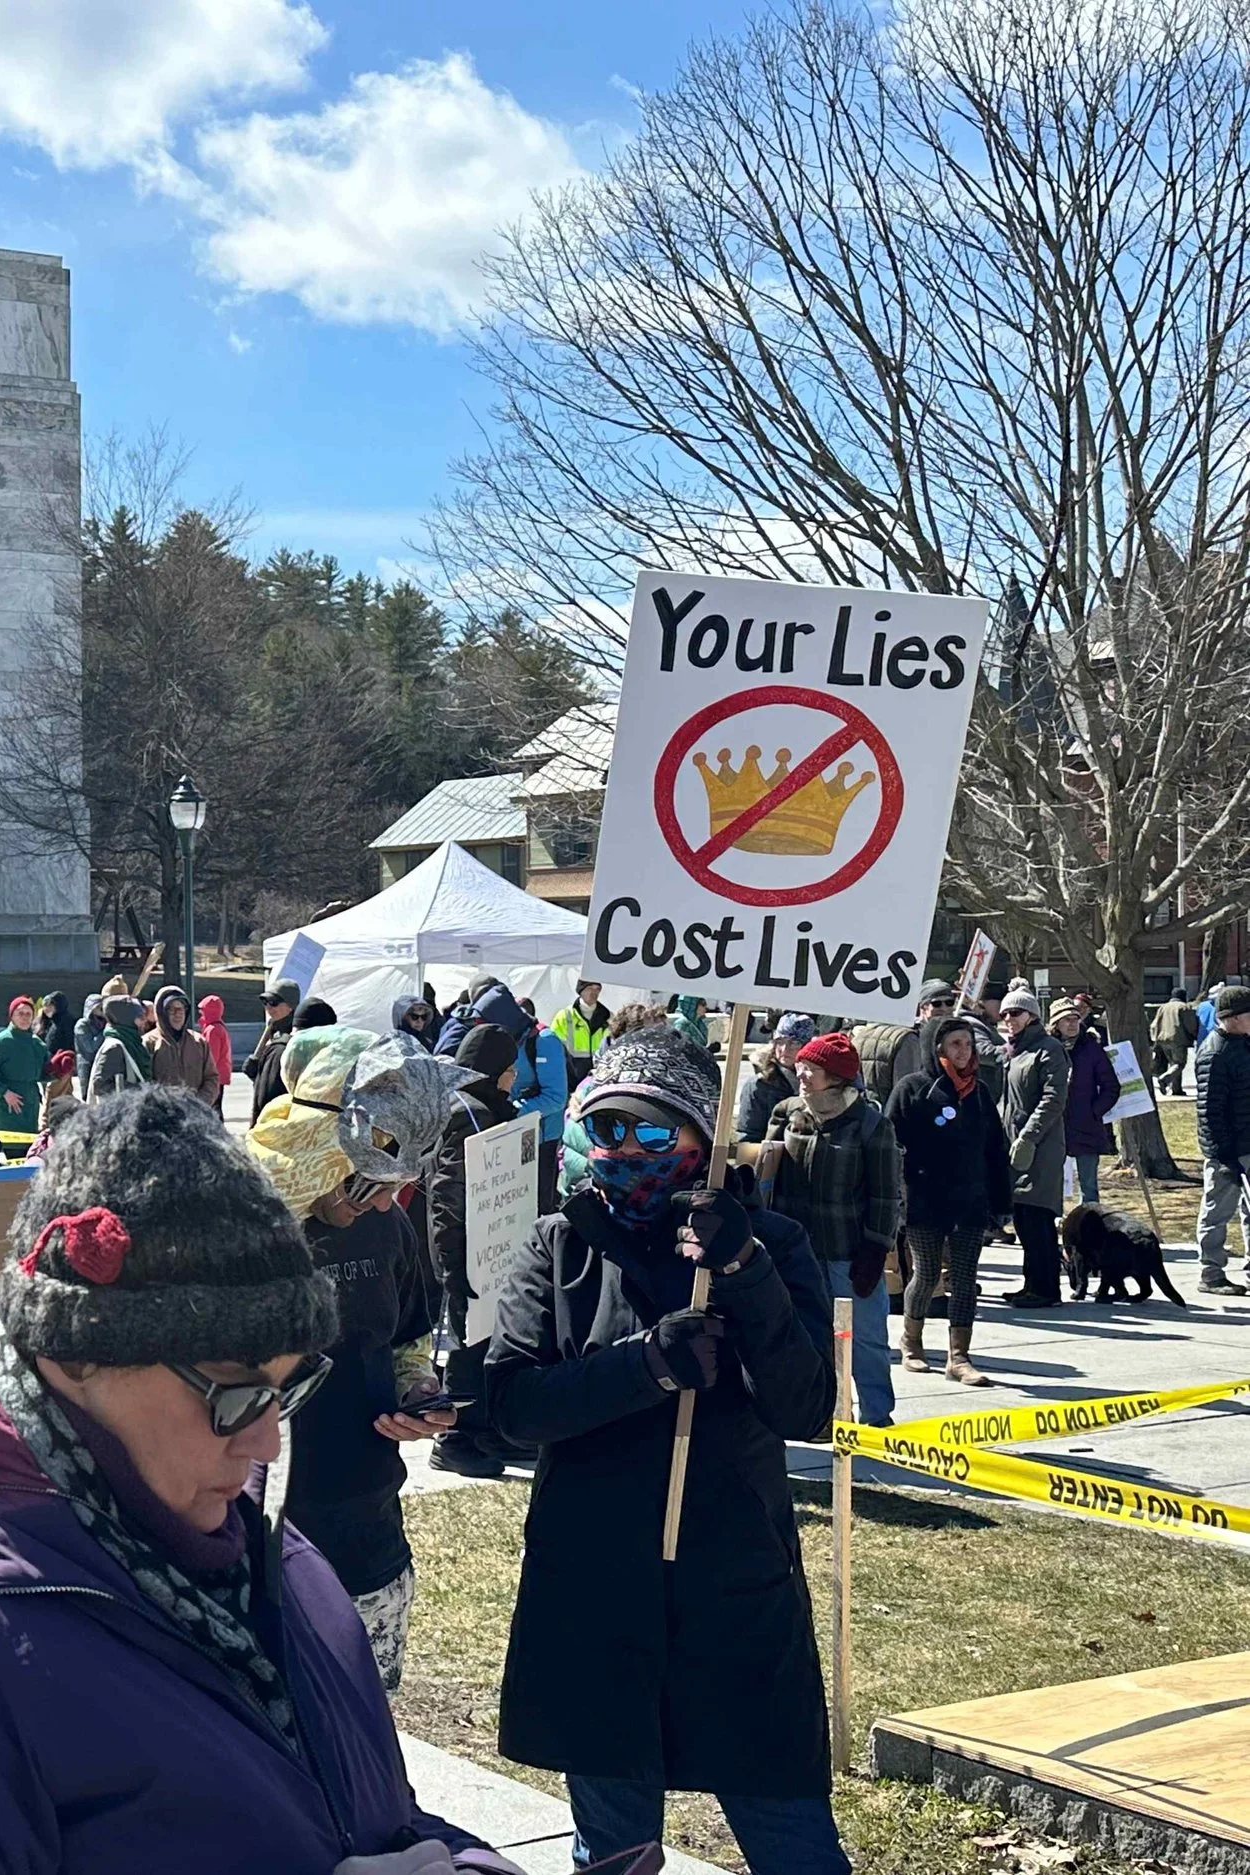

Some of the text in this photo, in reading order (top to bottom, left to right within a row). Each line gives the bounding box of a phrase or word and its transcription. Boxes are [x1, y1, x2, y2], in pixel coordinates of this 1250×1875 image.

[651, 586, 966, 690] Your Lies
[594, 896, 744, 979] Cost
[753, 914, 918, 1000] Lives
[483, 1146, 502, 1171] WE
[470, 1169, 516, 1197] THE PEOPLE
[476, 1184, 529, 1214] ARE AMERICA
[487, 1212, 517, 1236] NOT THE
[476, 1239, 511, 1268] VICIOUS
[343, 1260, 358, 1280] OF
[884, 1436, 970, 1480] CAUTION
[1048, 1472, 1124, 1515] ENTER
[1129, 1491, 1183, 1527] NOT
